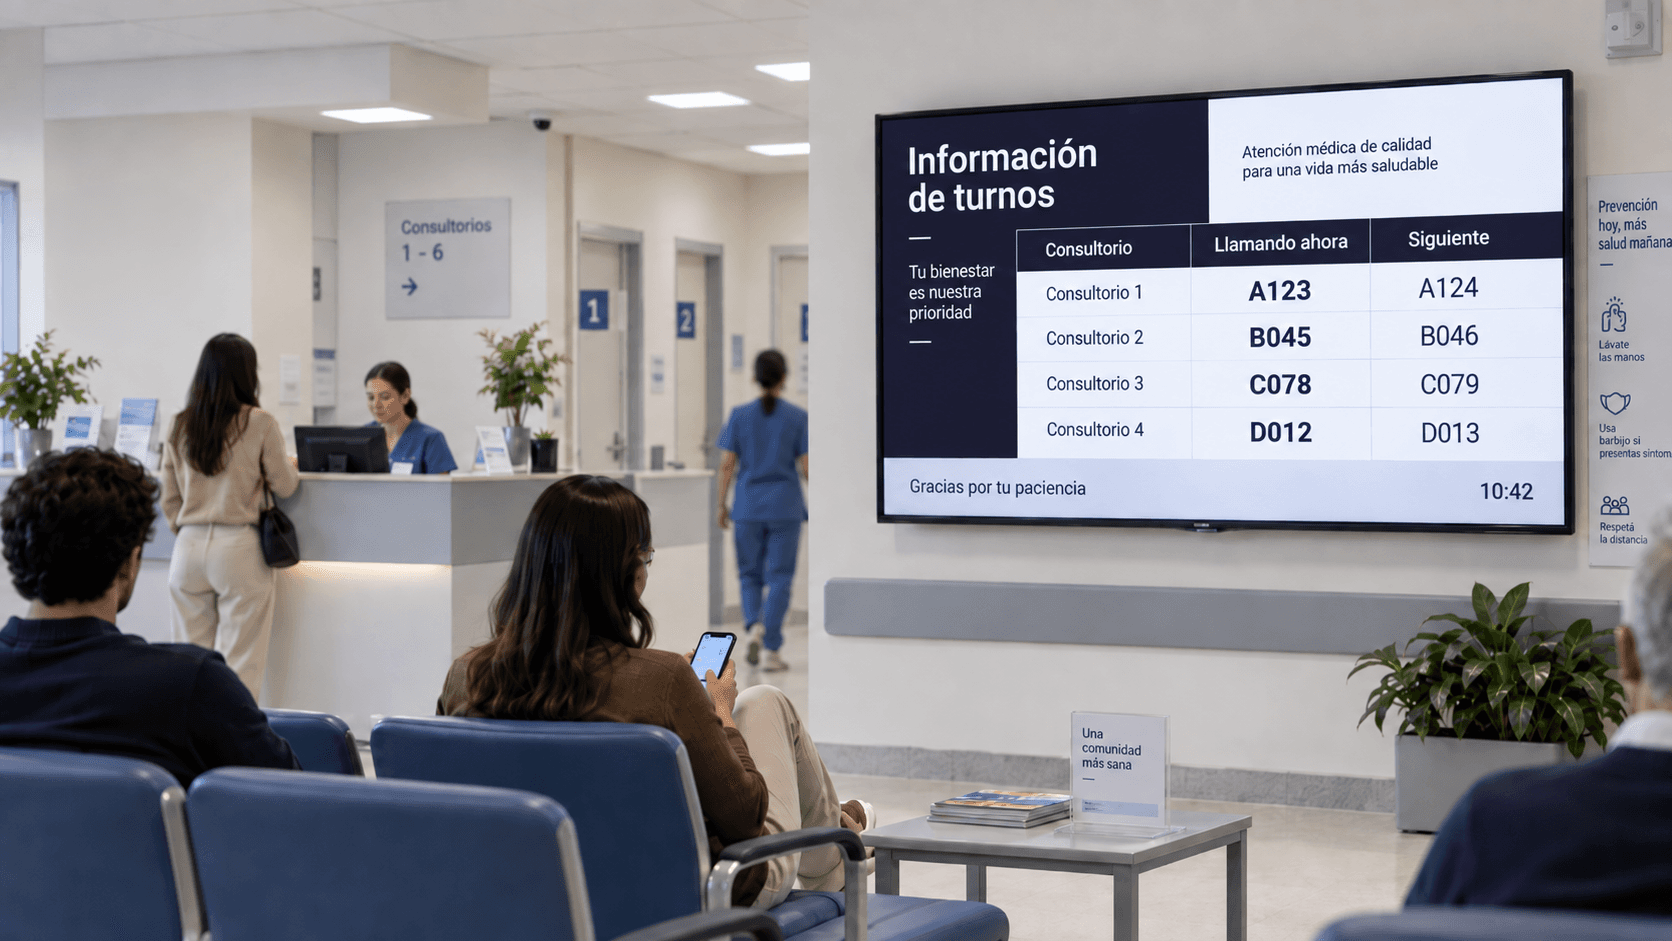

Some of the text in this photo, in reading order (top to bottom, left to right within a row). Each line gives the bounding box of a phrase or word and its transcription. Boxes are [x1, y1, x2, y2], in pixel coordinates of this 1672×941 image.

[909, 137, 1097, 176] Información
[1241, 135, 1432, 159] Atención médica de calidad
[1242, 155, 1439, 182] para una vida más saludable
[908, 182, 1055, 213] de turnos
[1598, 197, 1658, 214] Prevención
[401, 218, 492, 235] Consultorios
[1598, 216, 1648, 235] hoy, más
[1045, 239, 1133, 258] Consultorio
[1214, 233, 1349, 253] Llamando ahora
[1408, 229, 1490, 251] Siguiente
[1598, 234, 1672, 251] salud mañana
[402, 243, 411, 262] 1
[432, 242, 445, 262] 6
[909, 263, 996, 280] Tu bienestar
[908, 284, 982, 300] es nuestra
[1046, 284, 1142, 302] Consultorio 1
[1248, 279, 1312, 302] A123
[1418, 276, 1479, 299] A124
[586, 298, 601, 324] 1
[679, 308, 692, 333] 2
[908, 303, 972, 323] prioridad
[1046, 329, 1144, 346] Consultorio 2
[1250, 326, 1312, 348] B045
[1421, 324, 1479, 347] B046
[1598, 338, 1630, 350] Lávate
[1598, 352, 1645, 362] las manos
[1046, 375, 1144, 391] Consultorio 3
[1249, 373, 1312, 395] C078
[1421, 373, 1480, 395] C079
[1046, 421, 1145, 437] Consultorio 4
[1250, 421, 1313, 443] D012
[1422, 422, 1480, 443] D013
[1599, 423, 1617, 433] Usa
[1599, 435, 1641, 448] barbijo si
[1599, 448, 1672, 460] presentas sintom
[910, 478, 1086, 499] Gracias por tu paciencia
[1480, 482, 1534, 501] 10:42
[1599, 521, 1635, 534] Respetá
[1599, 534, 1648, 545] la distancia
[1082, 727, 1104, 739] Una
[1081, 743, 1142, 757] comunidad
[1082, 756, 1132, 770] más sana
